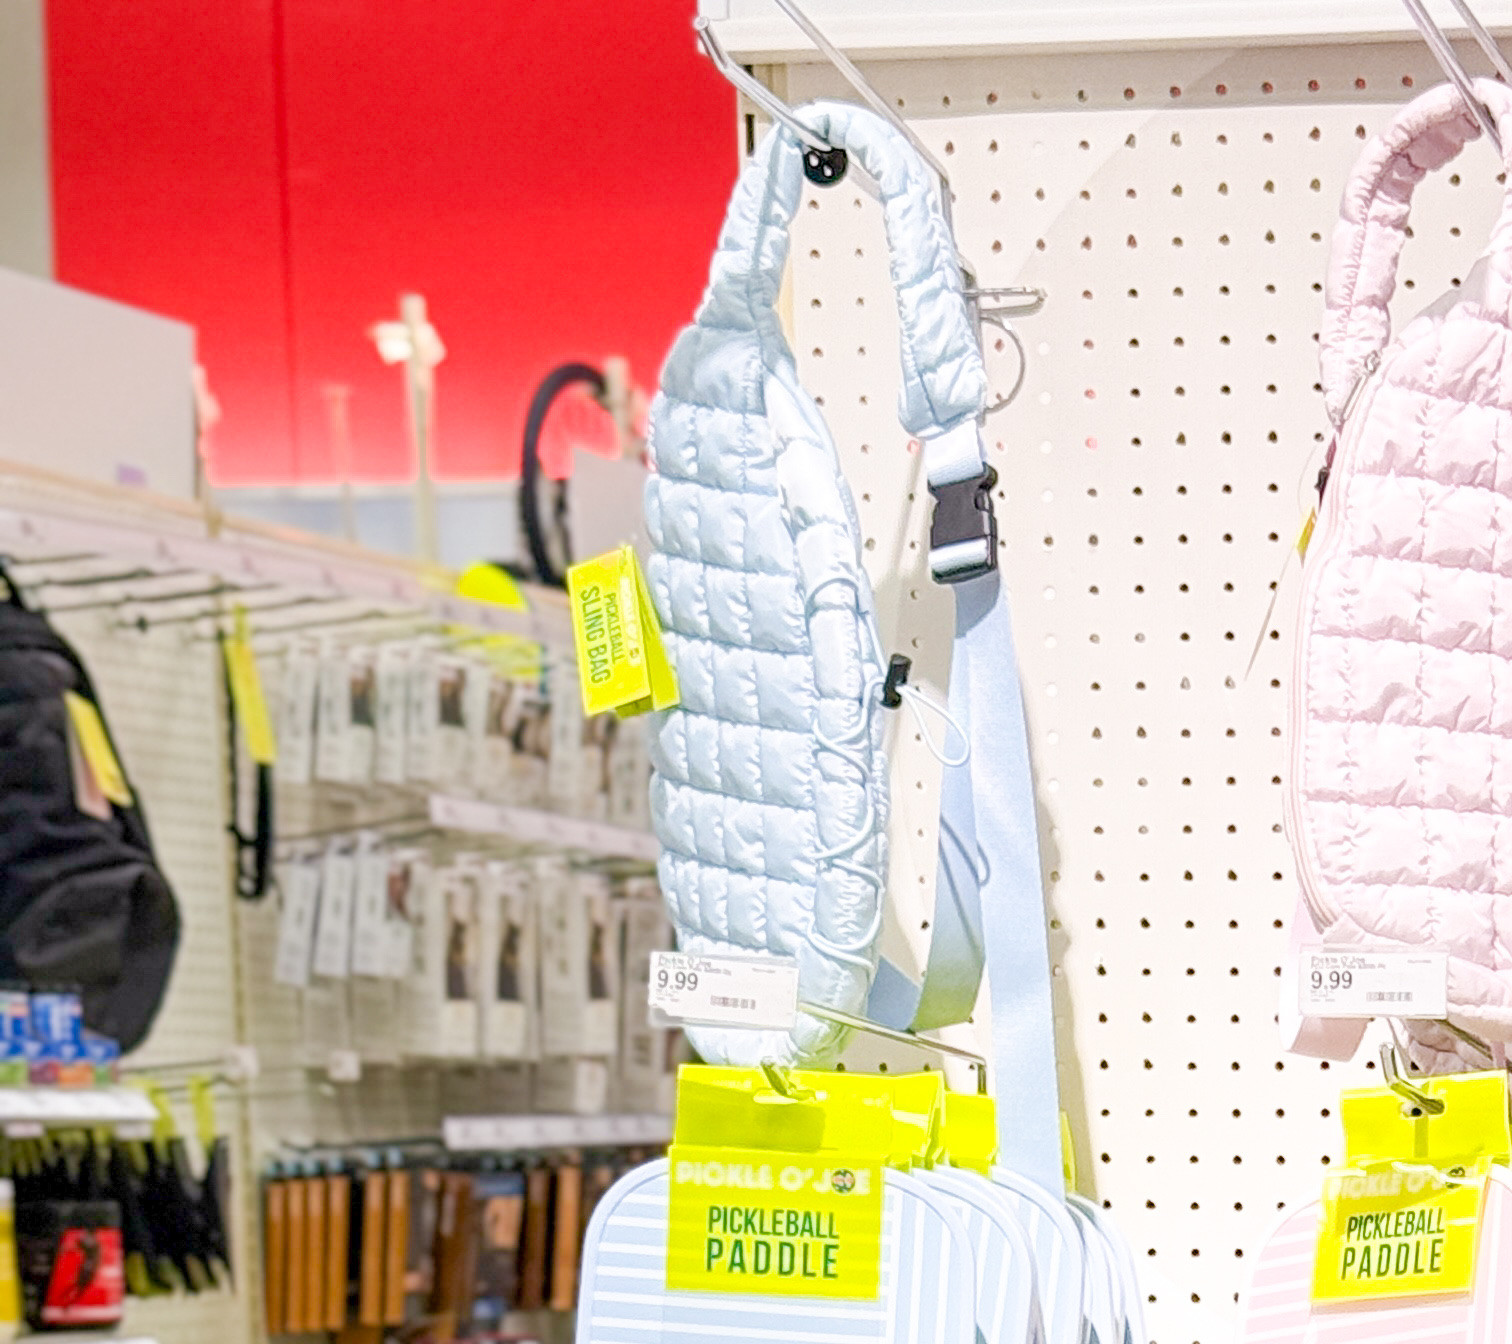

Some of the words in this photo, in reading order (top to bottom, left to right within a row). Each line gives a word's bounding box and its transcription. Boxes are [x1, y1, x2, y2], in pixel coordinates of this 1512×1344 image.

[581, 585, 605, 642] SLING
[604, 592, 625, 665] PICKLEBALL
[588, 644, 611, 684] BAG
[657, 970, 698, 991] 9.99
[1311, 970, 1352, 989] 9.99
[674, 1161, 773, 1190] PICKLE
[708, 1205, 839, 1239] PICKLEBALL
[1346, 1207, 1445, 1242] PICKLEBALL
[706, 1238, 840, 1279] PADDLE
[1341, 1238, 1443, 1280] PADDLE
